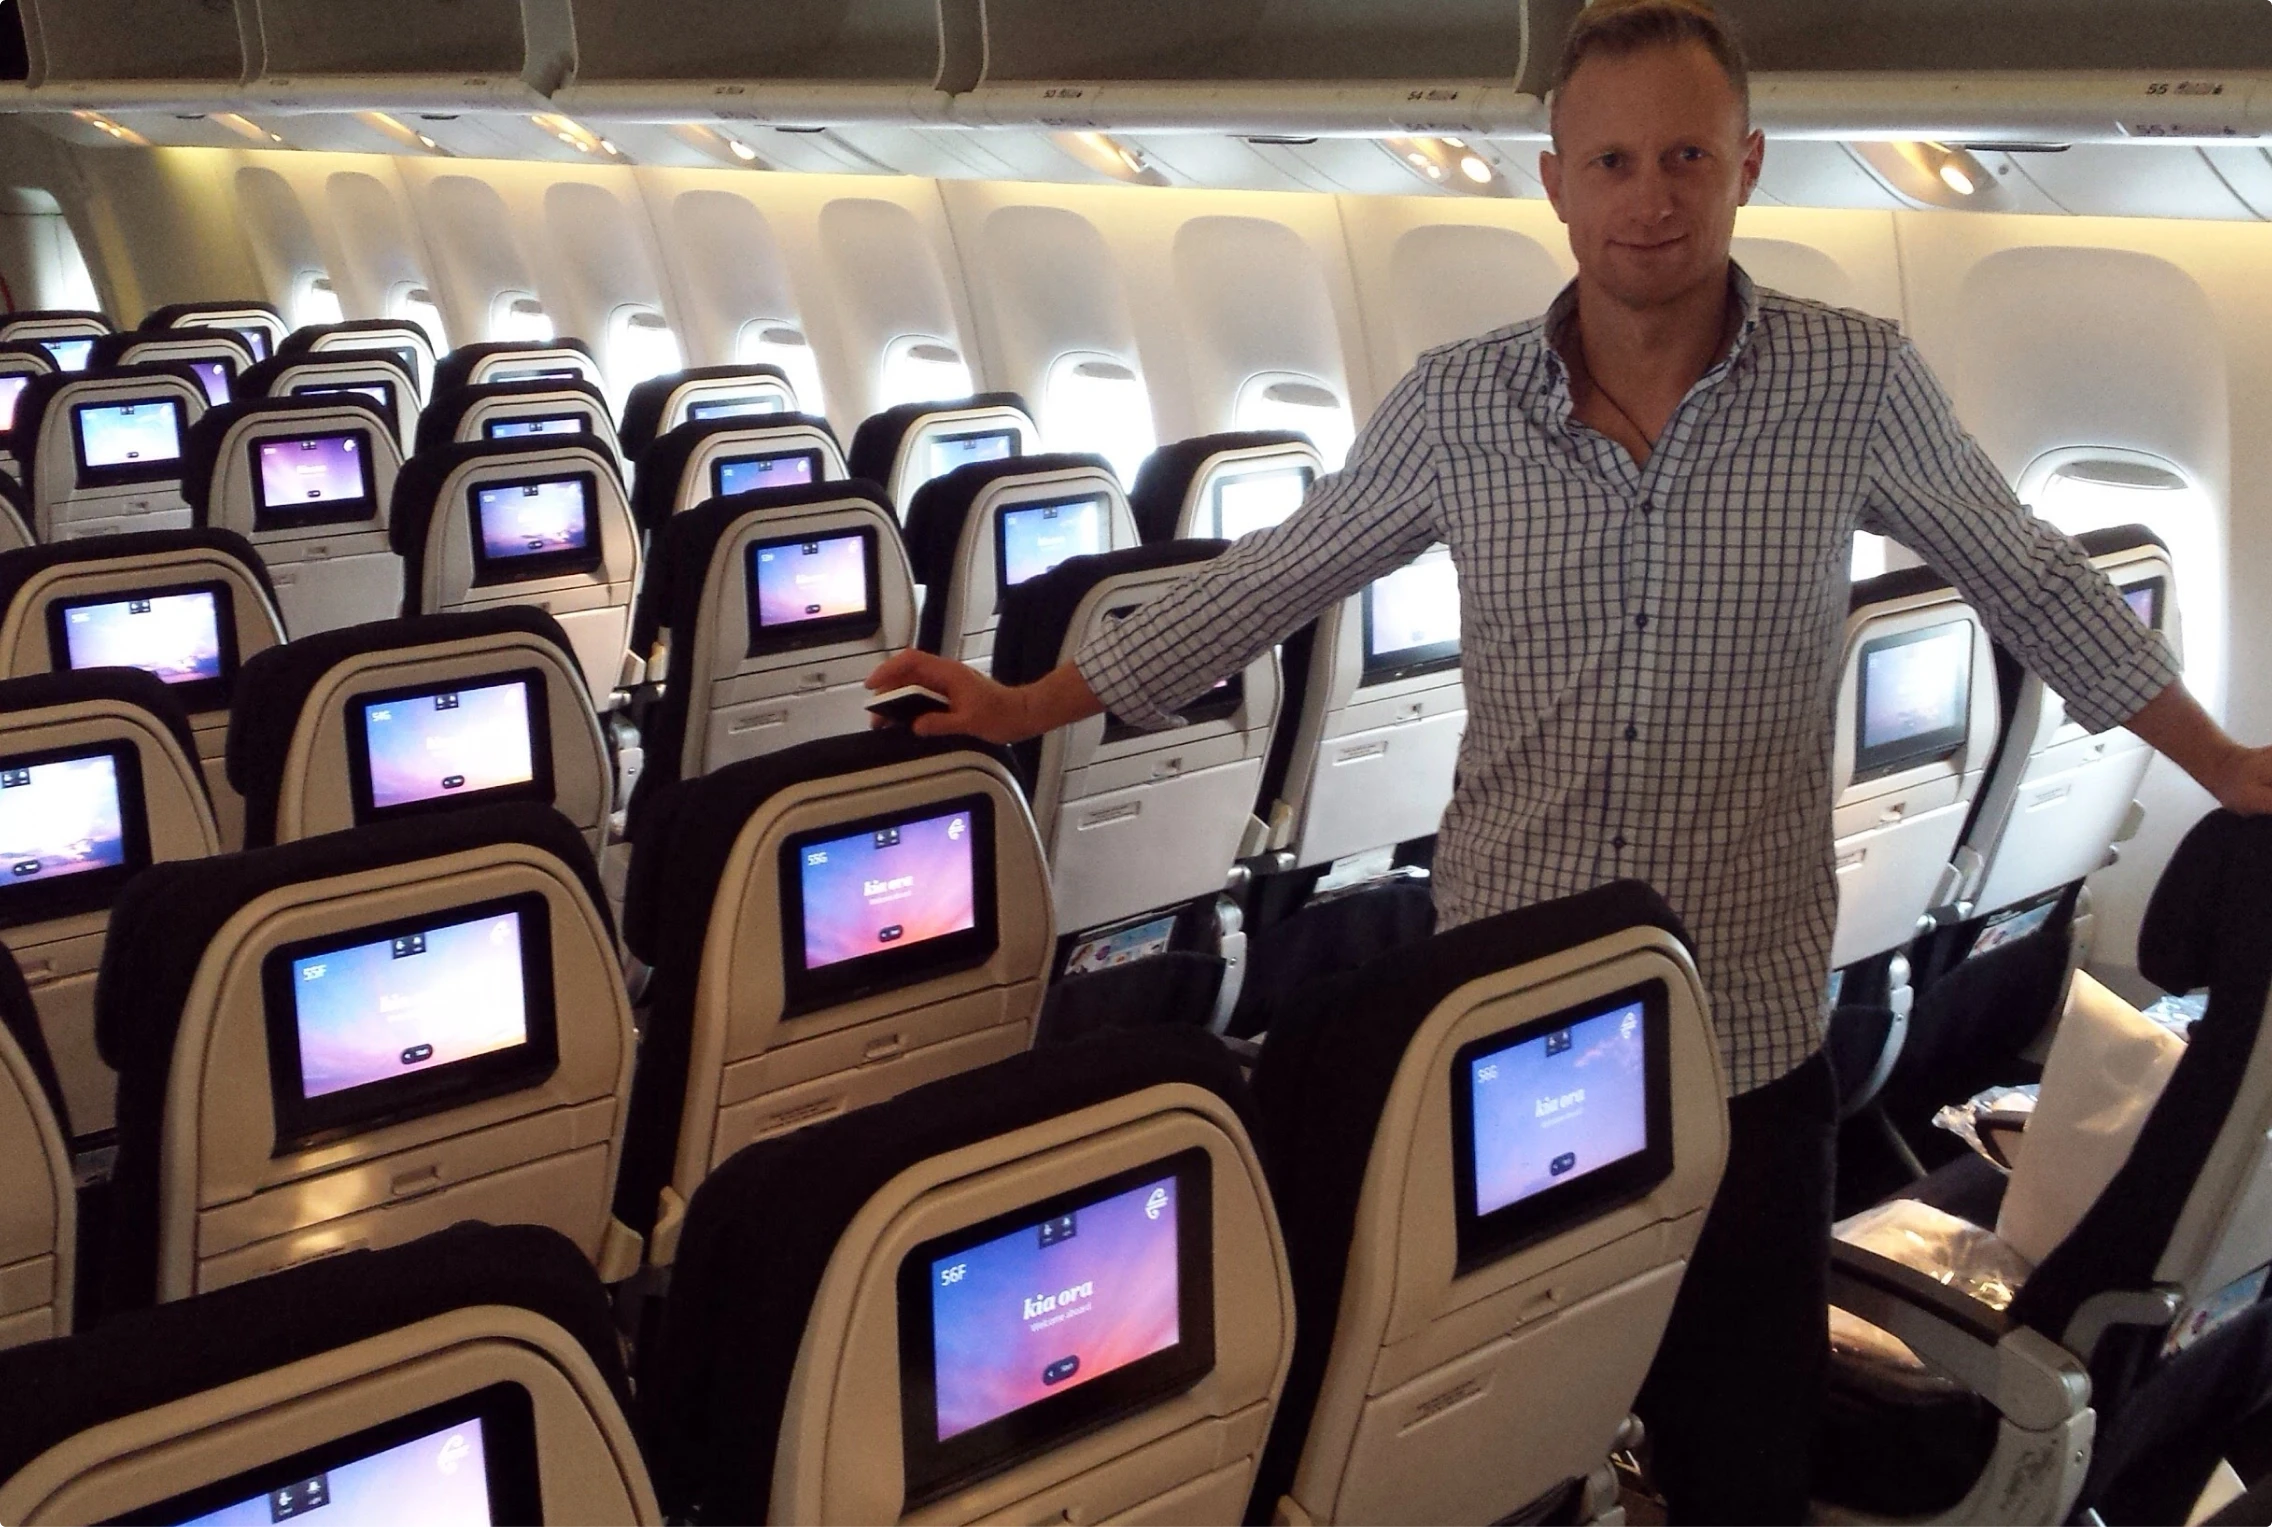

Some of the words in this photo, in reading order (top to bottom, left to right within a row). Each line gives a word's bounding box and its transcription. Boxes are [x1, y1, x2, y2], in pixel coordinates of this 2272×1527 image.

[2145, 83, 2170, 95] 55
[940, 1263, 967, 1286] 56F
[1023, 1293, 1057, 1320] kia
[1057, 1281, 1094, 1307] ora
